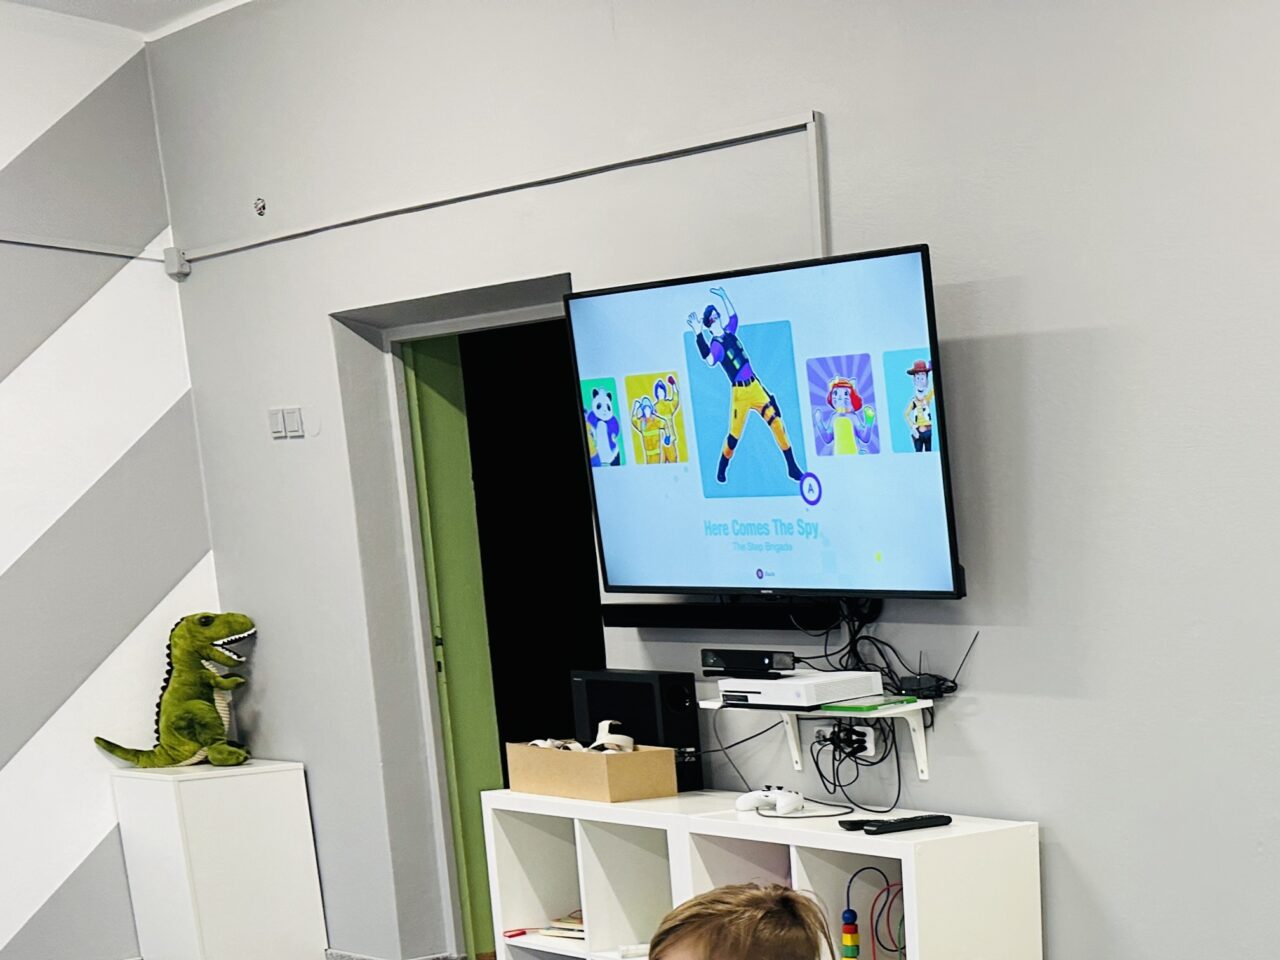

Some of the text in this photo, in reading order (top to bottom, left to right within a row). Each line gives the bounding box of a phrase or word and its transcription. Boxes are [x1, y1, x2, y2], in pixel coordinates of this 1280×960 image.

[807, 483, 815, 494] A
[703, 518, 819, 539] Here Comes The Spy
